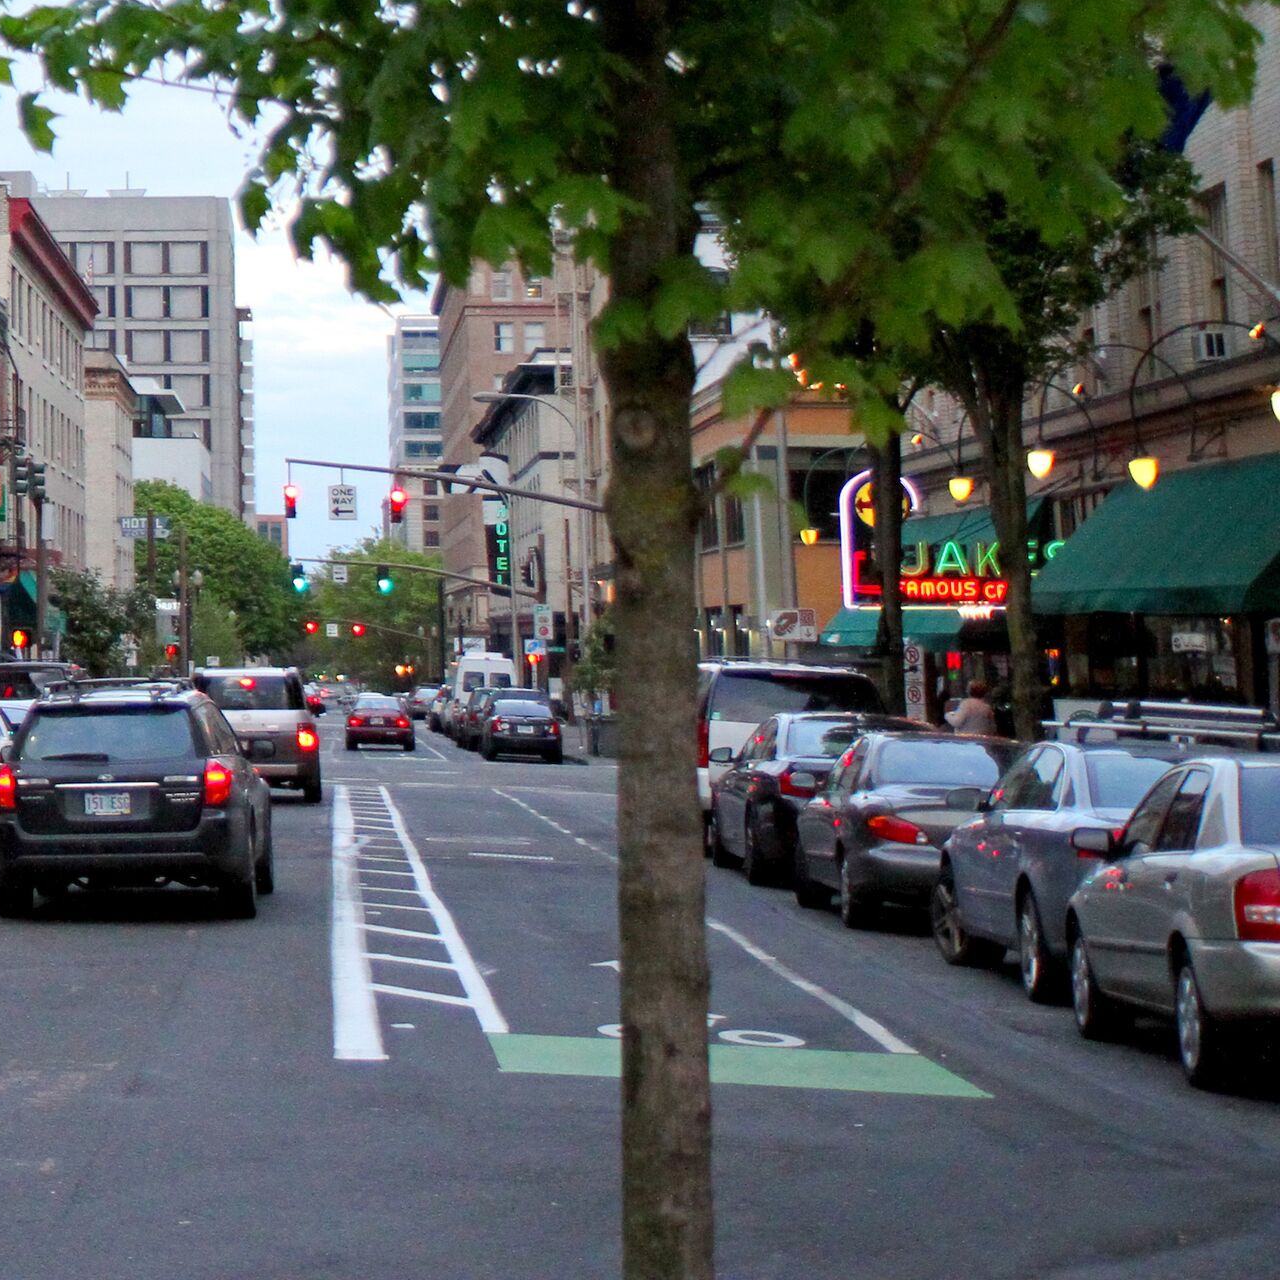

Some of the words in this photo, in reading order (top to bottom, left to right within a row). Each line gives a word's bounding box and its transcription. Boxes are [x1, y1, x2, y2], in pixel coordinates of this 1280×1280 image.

[331, 488, 353, 496] ONE
[332, 497, 353, 505] WAY
[122, 517, 163, 529] HOTL
[86, 796, 104, 810] 151
